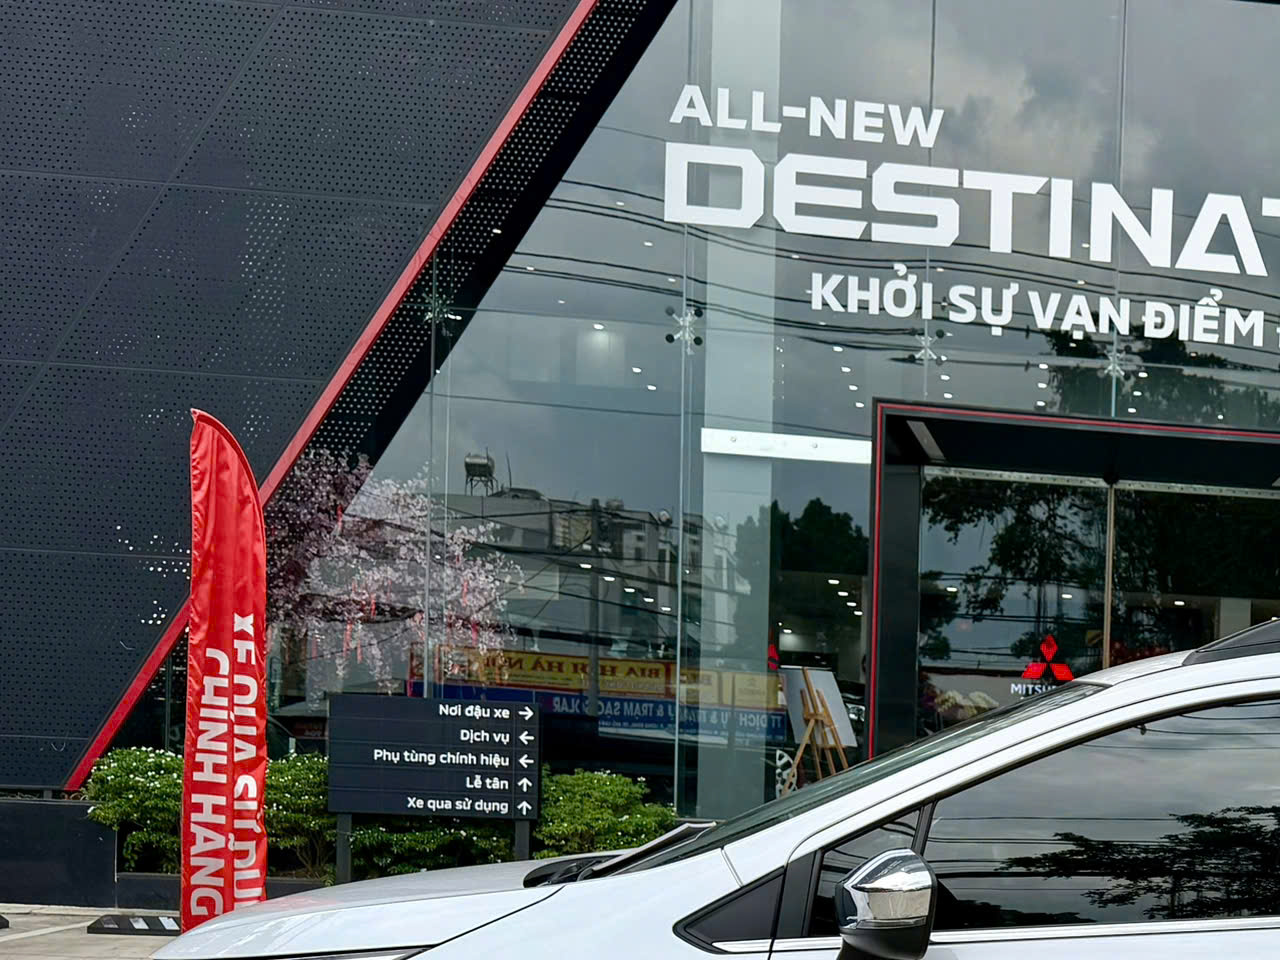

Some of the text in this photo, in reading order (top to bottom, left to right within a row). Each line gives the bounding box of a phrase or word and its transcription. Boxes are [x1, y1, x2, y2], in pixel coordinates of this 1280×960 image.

[669, 84, 945, 148] ALL-NEW
[811, 263, 933, 320] KHỞI
[949, 283, 1019, 336] SỰ
[1027, 291, 1130, 340] VẠN
[1141, 288, 1264, 347] ĐIỂM
[1010, 683, 1057, 695] MITSU
[439, 703, 510, 719] Nơi đậu xe
[460, 729, 510, 745] Dịch vụ
[373, 748, 510, 768] Phụ tùng chính hiệu
[189, 648, 236, 916] CHÍNH HÃNG
[465, 774, 509, 790] Lễ tân
[407, 796, 509, 815] Xe qua sử dụng
